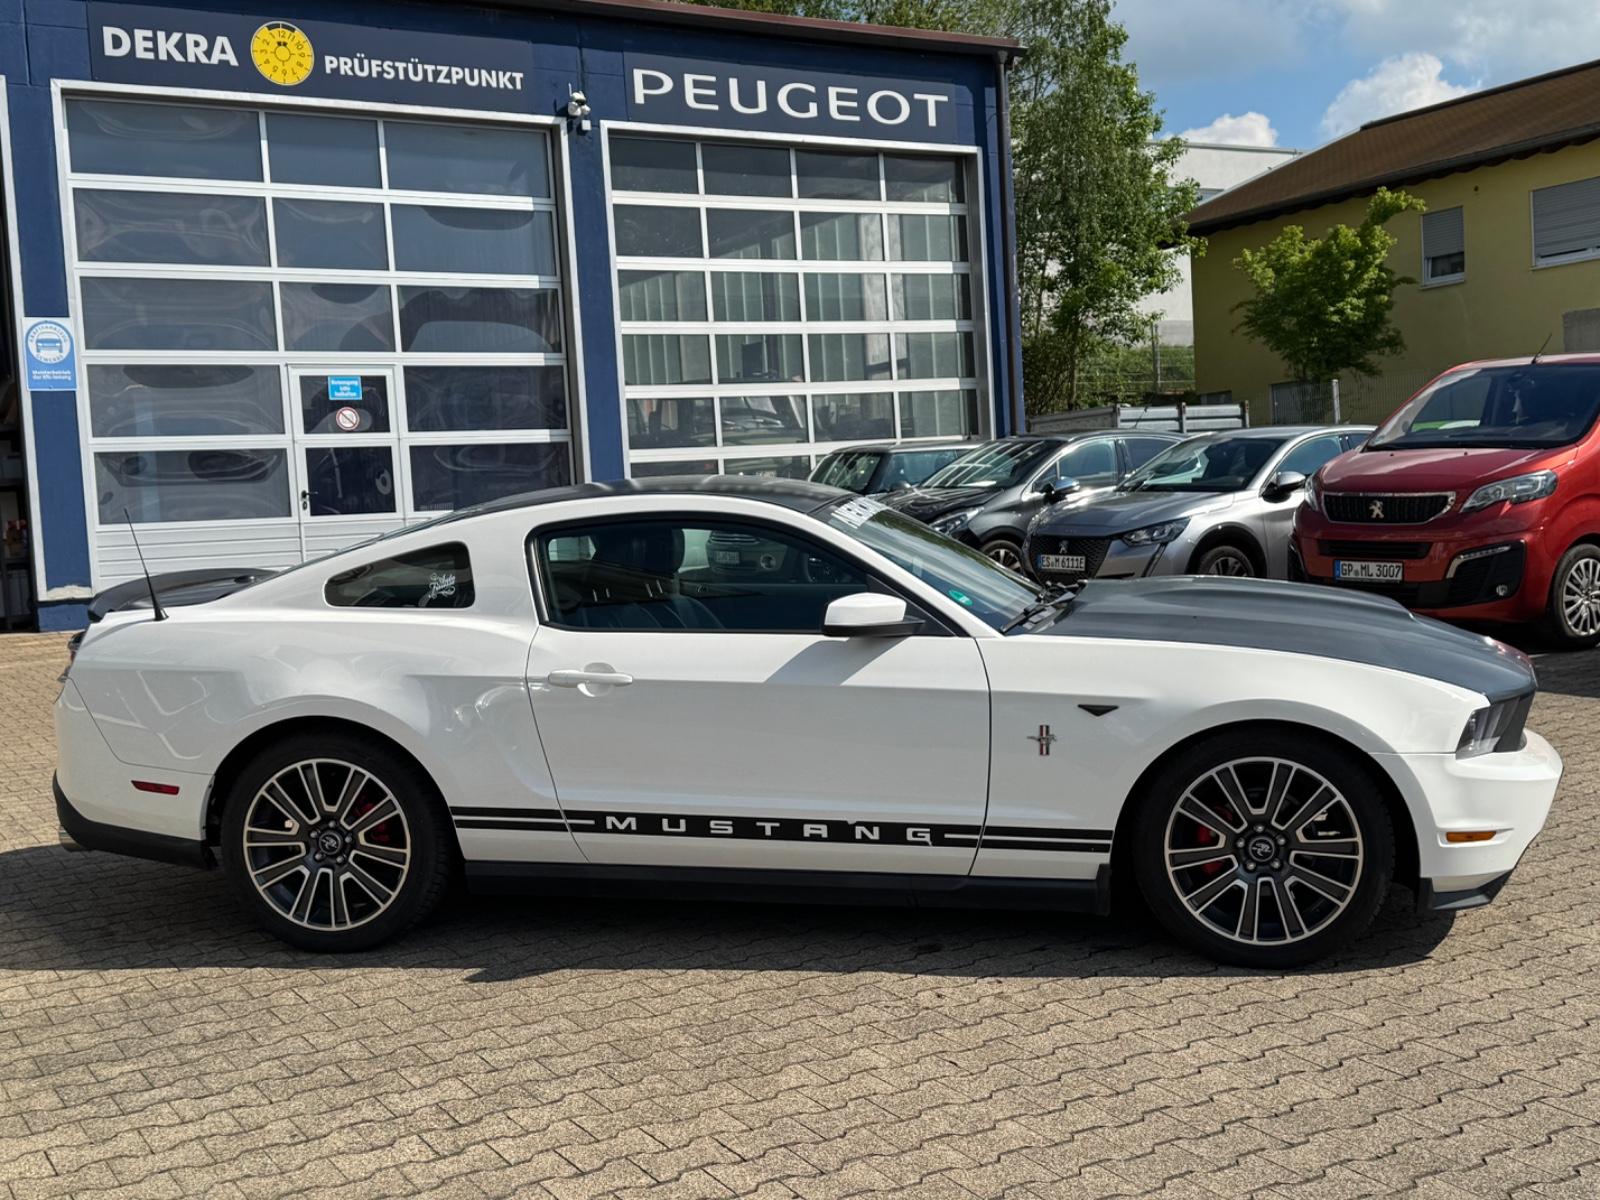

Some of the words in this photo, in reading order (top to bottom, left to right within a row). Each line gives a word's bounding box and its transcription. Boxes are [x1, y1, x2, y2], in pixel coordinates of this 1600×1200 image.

[278, 30, 286, 39] 12
[287, 33, 296, 42] 11
[101, 26, 239, 67] DEKRA
[295, 40, 304, 50] 10
[324, 53, 524, 91] PRÜFSTÜTZPUNKT
[632, 68, 949, 127] PEUGEOT
[1041, 556, 1051, 568] ES
[1341, 563, 1354, 577] GP
[1360, 564, 1374, 577] ML
[1375, 564, 1402, 578] 3007
[605, 815, 932, 843] MUSTANG
